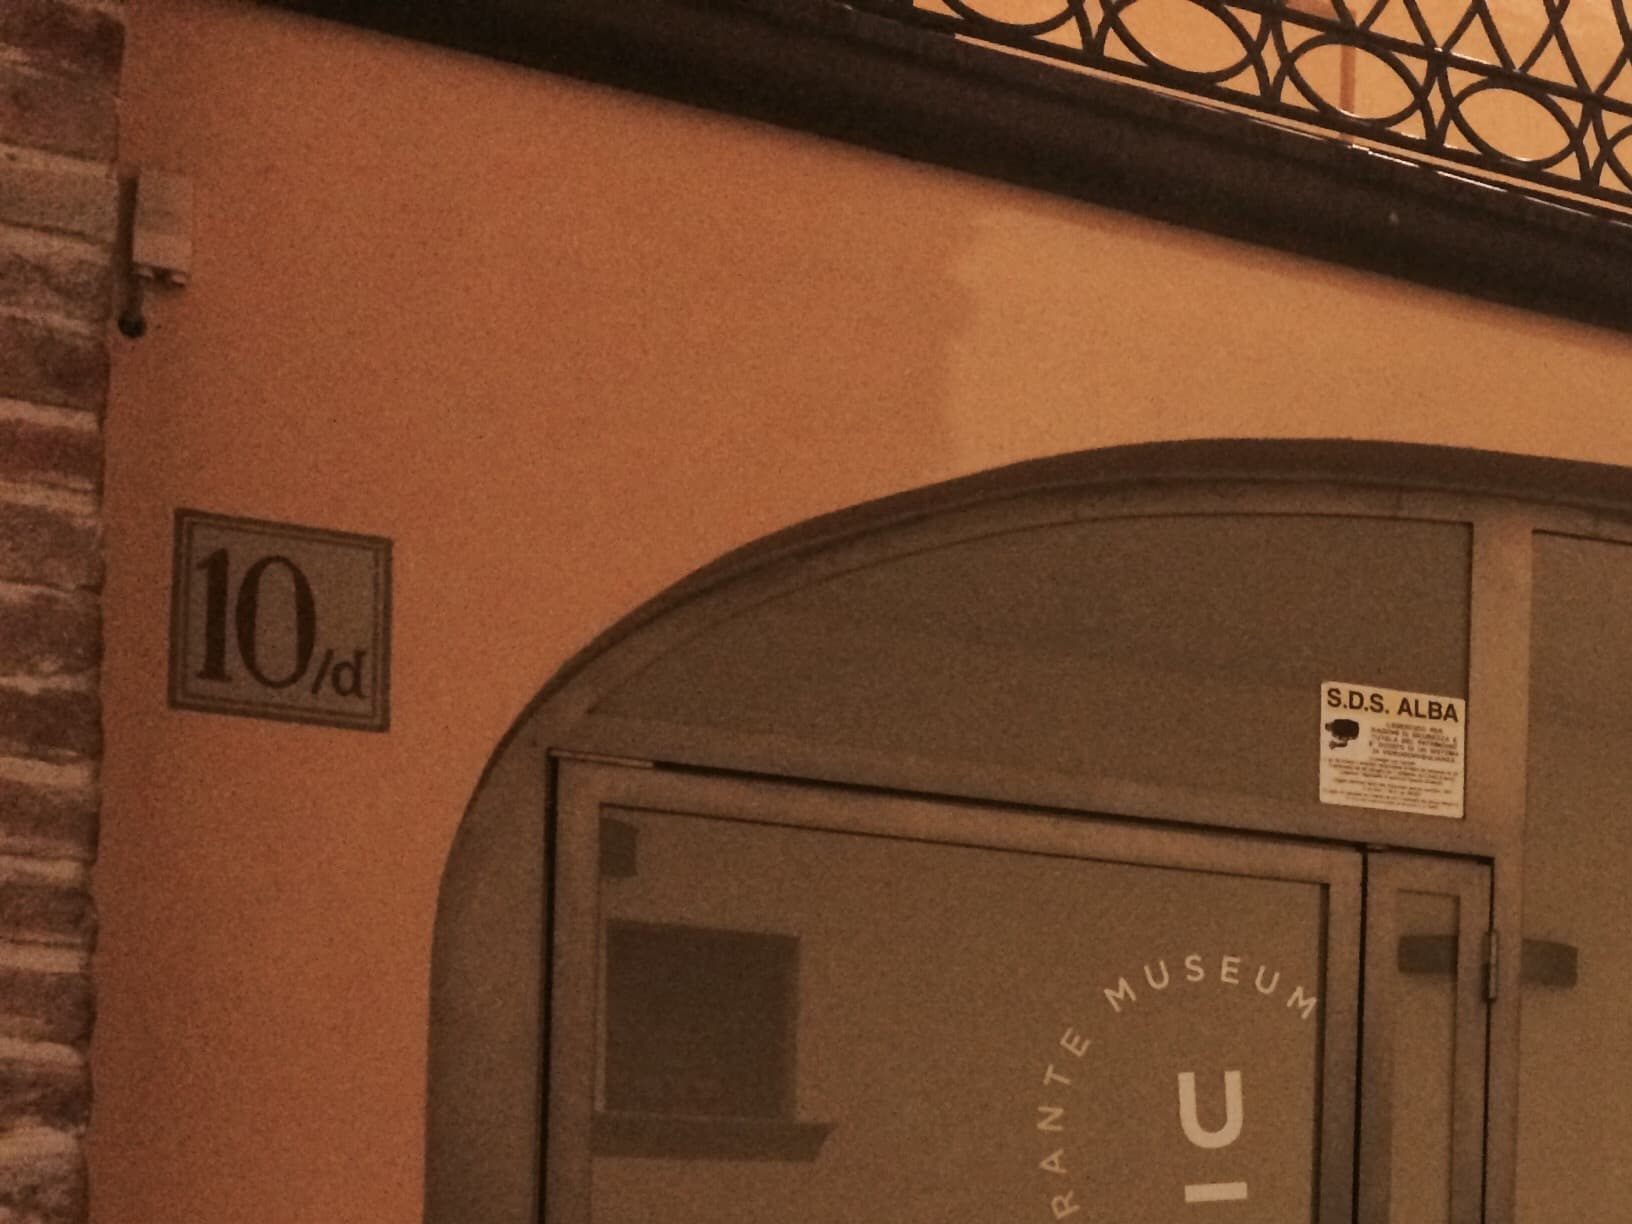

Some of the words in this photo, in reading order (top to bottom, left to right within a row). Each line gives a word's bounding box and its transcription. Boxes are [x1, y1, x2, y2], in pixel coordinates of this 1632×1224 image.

[195, 548, 367, 699] 10/d
[1327, 687, 1390, 715] S.D.S.
[1397, 697, 1459, 723] ALBA
[1103, 954, 1317, 1020] MUSEUM
